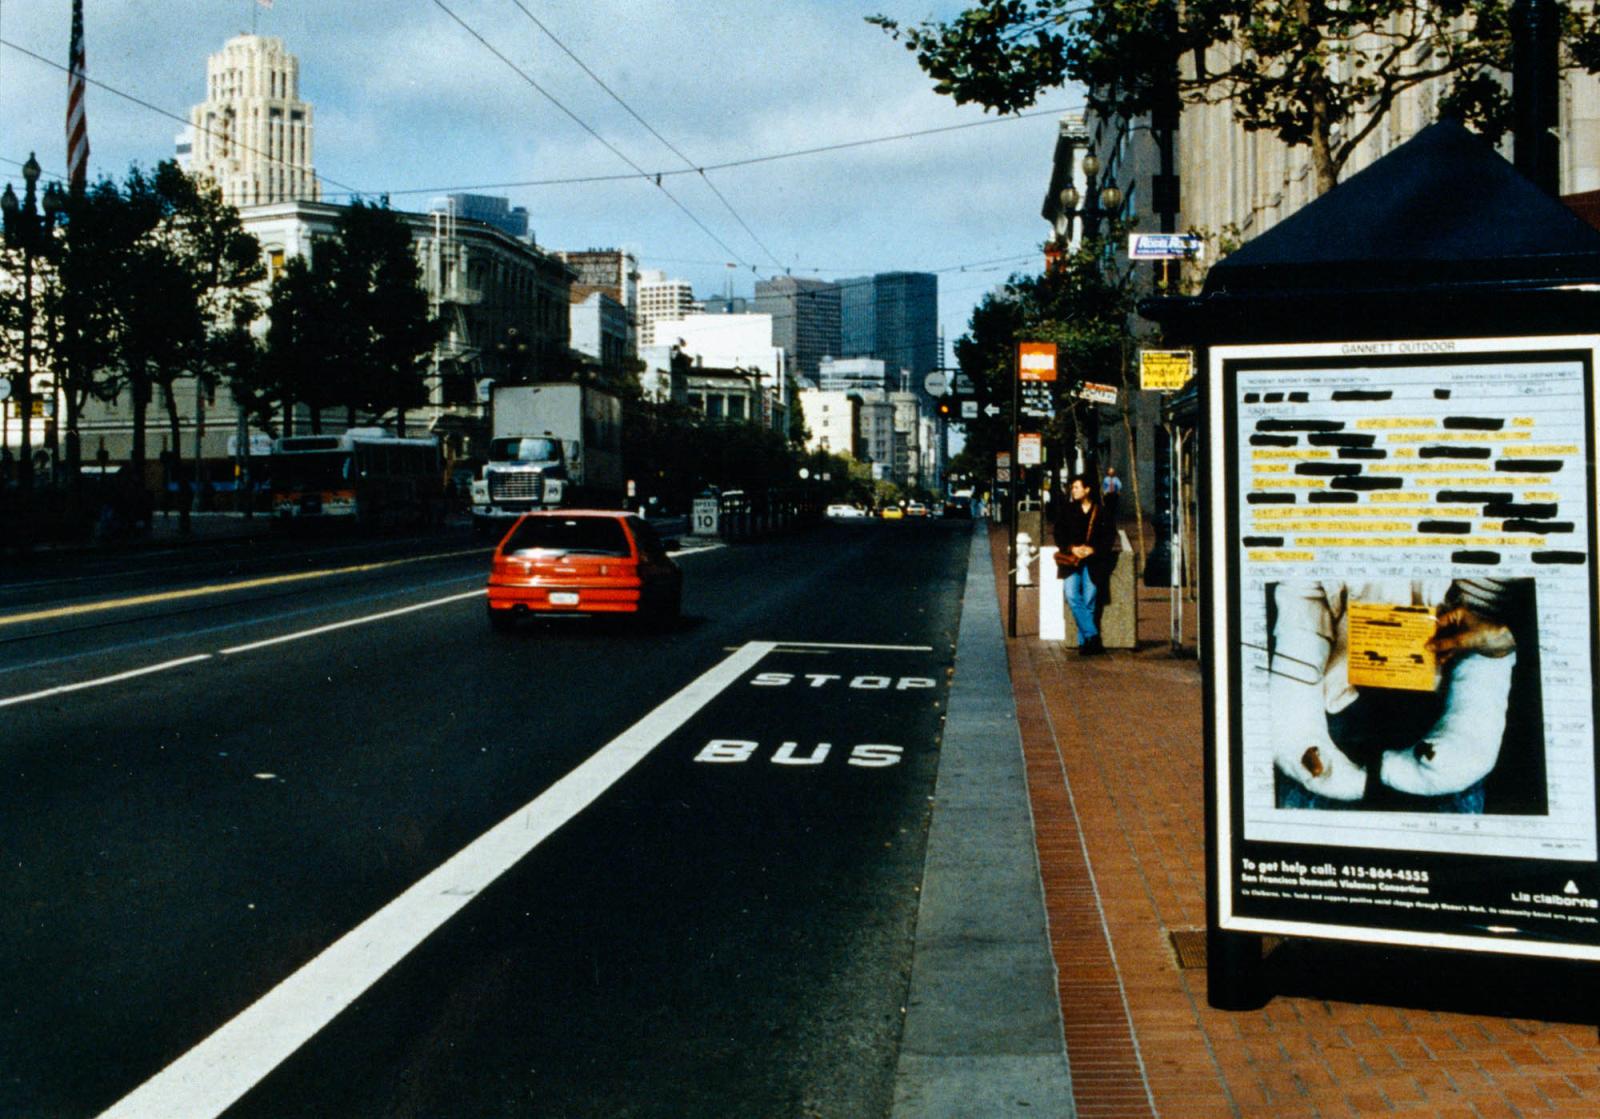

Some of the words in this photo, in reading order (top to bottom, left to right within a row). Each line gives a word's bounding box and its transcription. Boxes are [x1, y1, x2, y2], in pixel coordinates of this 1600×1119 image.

[1341, 343, 1391, 354] GANNETT
[1399, 341, 1455, 353] OUTDOOR
[697, 515, 713, 528] 10
[750, 672, 937, 690] STOP
[693, 739, 904, 767] BUS
[1242, 858, 1256, 870] To
[1258, 862, 1279, 874] get
[1281, 860, 1308, 876] help
[1310, 863, 1337, 876] call:
[1341, 865, 1429, 882] 415-864-4555
[1241, 873, 1258, 883] San
[1259, 874, 1298, 886] Francisco
[1299, 877, 1338, 888] Domestic
[1339, 879, 1377, 891] Violence
[1378, 882, 1430, 894] Consortium
